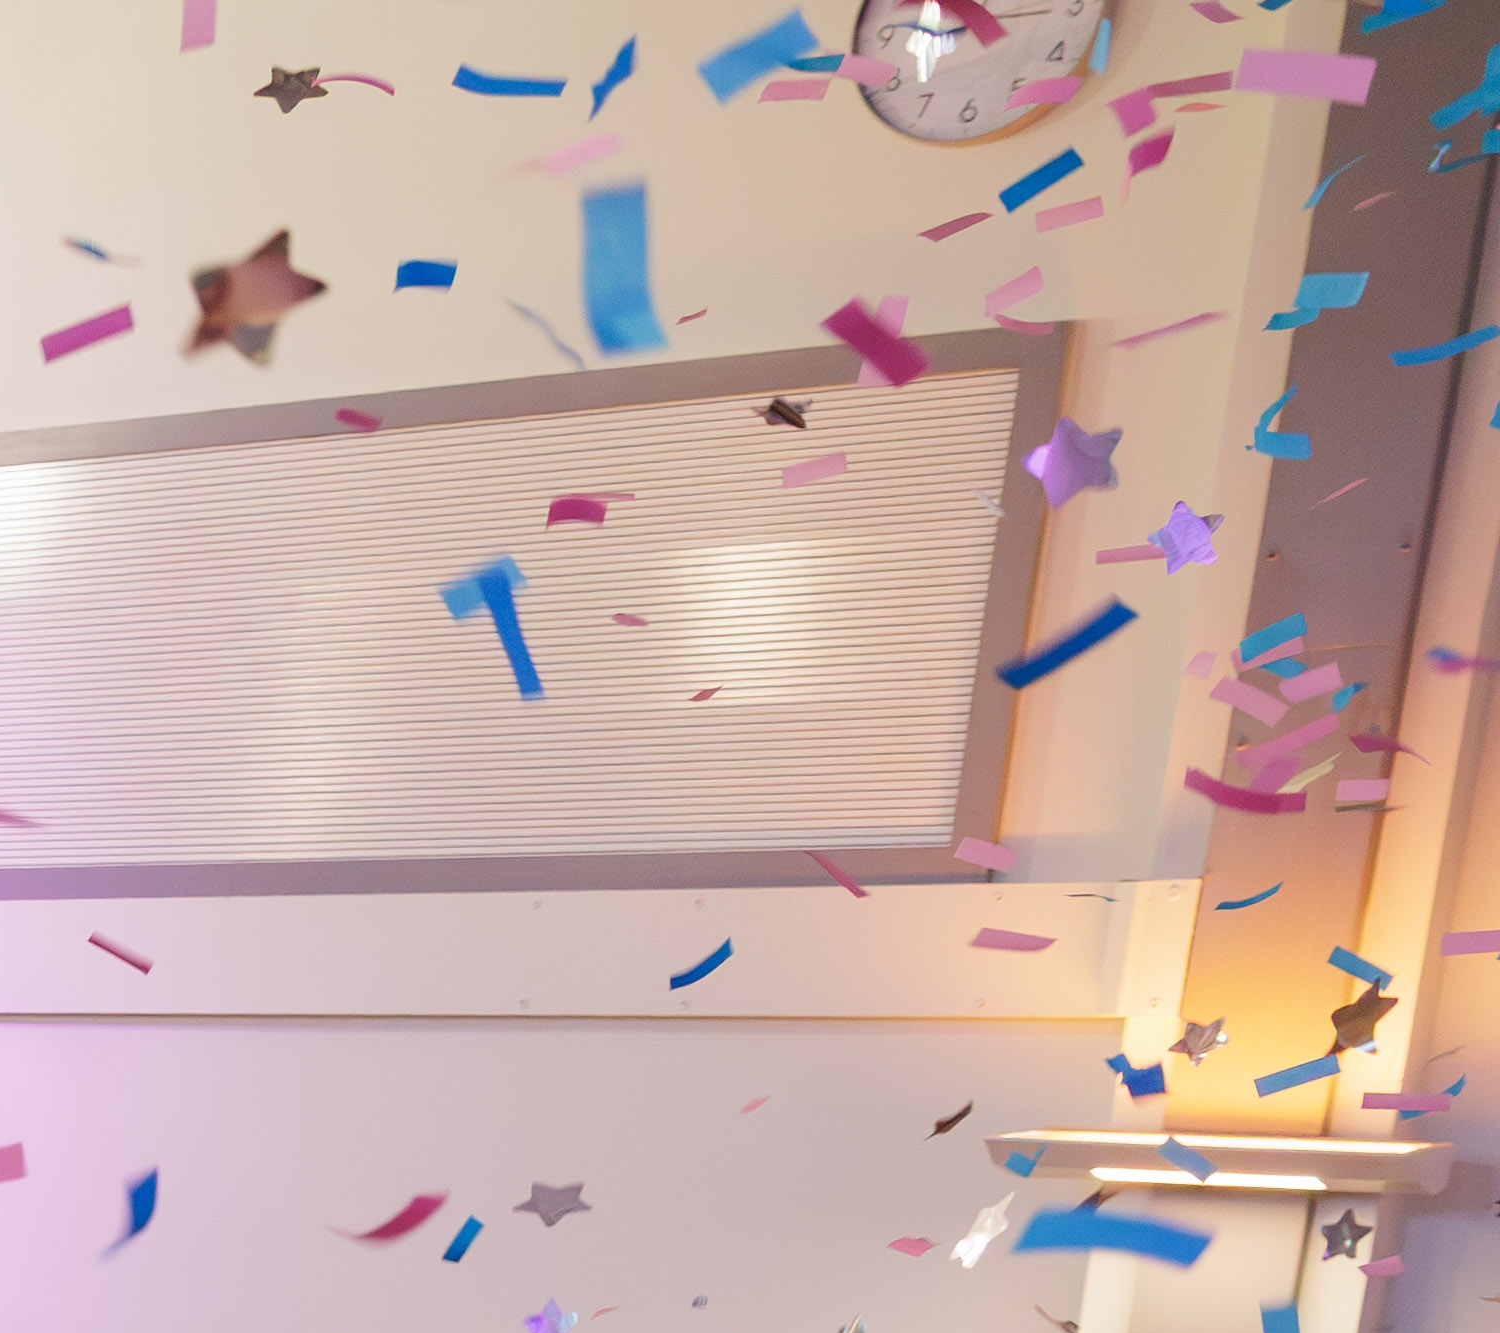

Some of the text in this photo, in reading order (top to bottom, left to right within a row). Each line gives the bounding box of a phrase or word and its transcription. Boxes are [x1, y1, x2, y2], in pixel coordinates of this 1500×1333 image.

[877, 24, 894, 49] 9
[1045, 40, 1065, 62] 4
[917, 92, 935, 119] 7
[959, 99, 978, 123] 6
